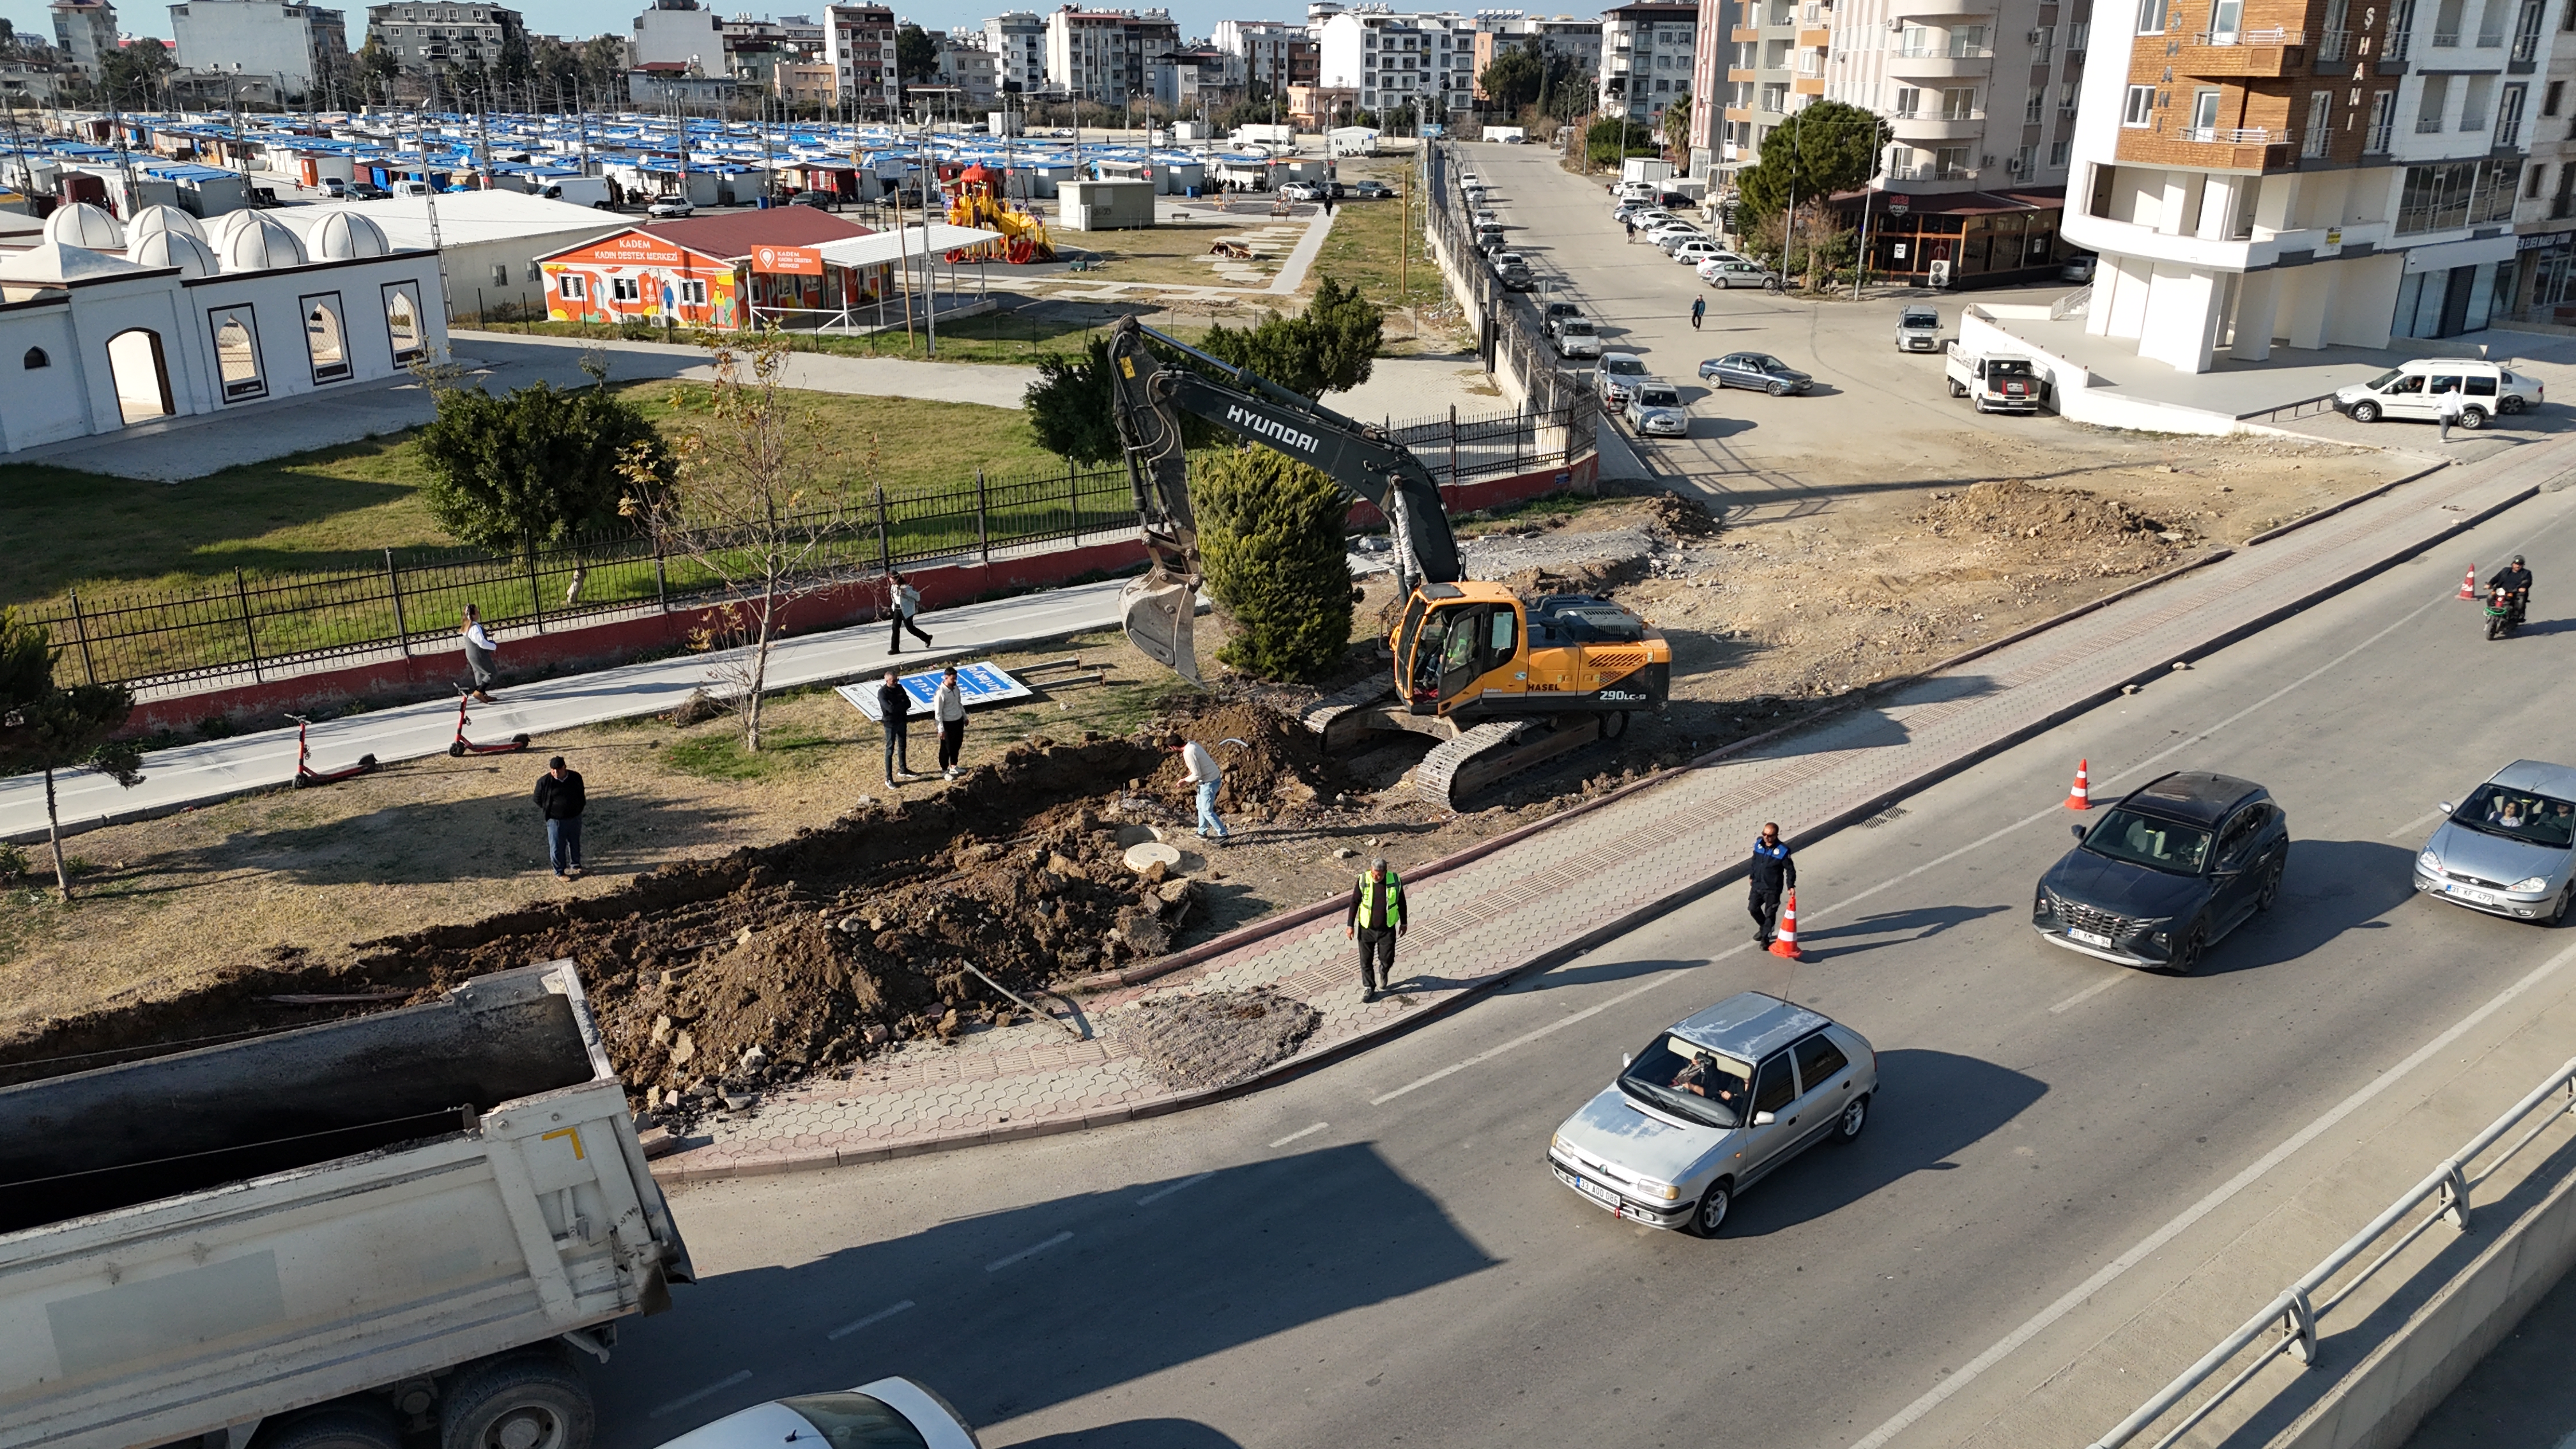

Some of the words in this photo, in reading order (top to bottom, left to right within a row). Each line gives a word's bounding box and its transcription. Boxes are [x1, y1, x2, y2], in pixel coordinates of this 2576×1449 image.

[619, 240, 650, 249] KADEM
[595, 250, 617, 259] KADIN
[617, 252, 645, 260] DESTEK
[647, 251, 678, 261] MERKEZİ
[1226, 404, 1319, 454] HYUNDAI
[967, 666, 1005, 691] Antakya
[1528, 684, 1560, 692] HASEL
[2478, 893, 2492, 901] 477
[2072, 929, 2079, 938] 31
[2083, 932, 2096, 942] KML
[2101, 937, 2110, 946] 94
[1581, 1179, 1588, 1190] 33
[1606, 1192, 1618, 1204] 086
